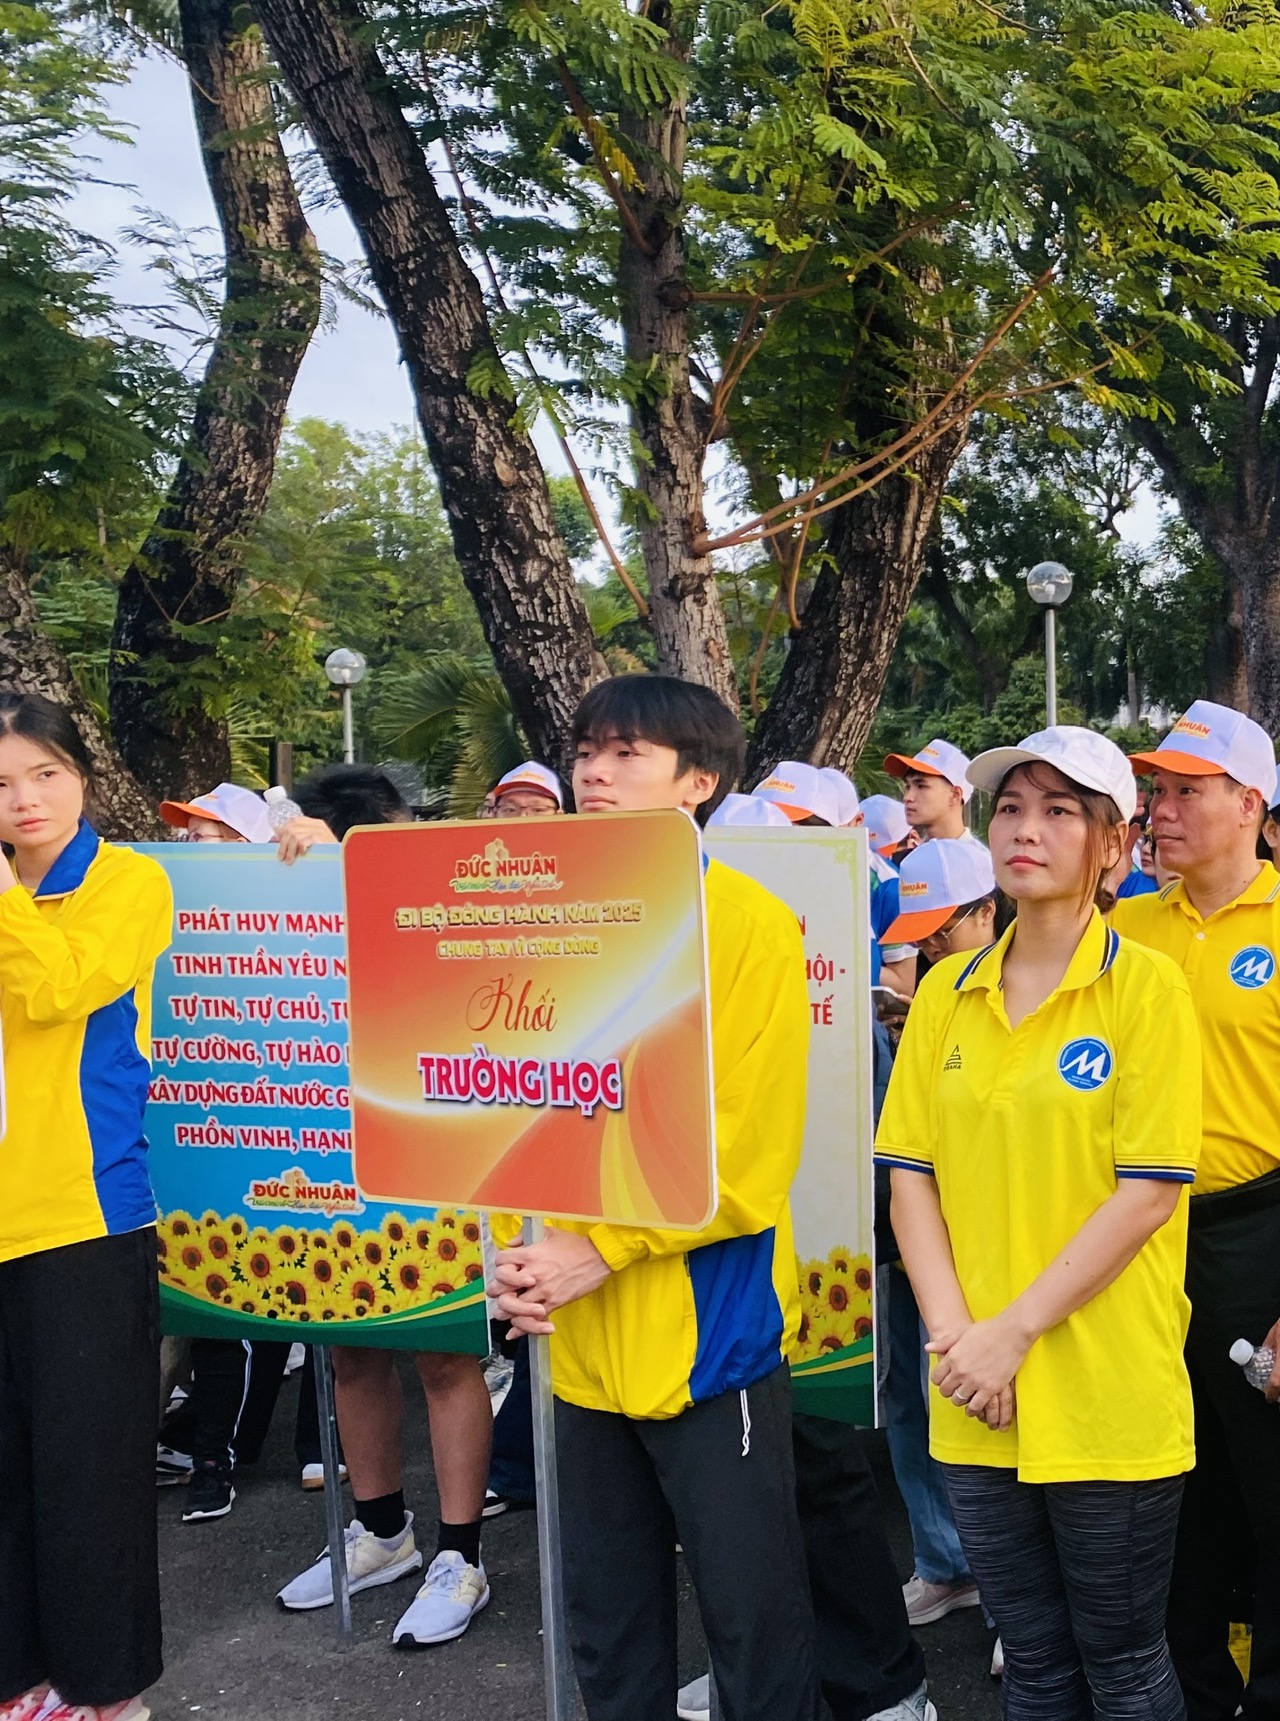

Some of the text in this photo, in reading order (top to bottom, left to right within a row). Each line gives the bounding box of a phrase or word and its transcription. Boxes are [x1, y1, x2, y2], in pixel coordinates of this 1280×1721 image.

[456, 853, 556, 880] ĐỨC NHUẬN
[178, 907, 231, 931] PHÁT
[237, 913, 280, 932] HUY
[396, 908, 417, 928] ĐI
[420, 904, 445, 932] BỘ
[504, 904, 560, 925] HÀNH
[602, 902, 643, 923] 2025
[172, 956, 223, 975] TINH
[227, 948, 283, 976] THẦN
[287, 953, 328, 977] YÊU
[438, 940, 483, 958] CHUNG
[485, 939, 512, 957] TAY
[171, 995, 198, 1023] TỰ
[201, 999, 243, 1022] TIN,
[246, 997, 272, 1025] TỰ
[277, 994, 328, 1023] CHỦ,
[465, 972, 558, 1032] Khối
[810, 993, 835, 1026] TẾ
[152, 1036, 179, 1065] TỰ
[184, 1036, 262, 1066] CƯỜNG,
[265, 1040, 292, 1067] TỰ
[298, 1038, 341, 1064] HÀO
[147, 1077, 182, 1101] XÂY
[185, 1080, 239, 1107] DỰNG
[240, 1077, 277, 1104] ĐẤT
[280, 1081, 334, 1107] NƯỚC
[418, 1043, 622, 1116] TRƯỜNG HỌC
[177, 1118, 352, 1153] PHỒN VINH, HẠN
[252, 1180, 357, 1205] ĐỨC NHUẬN
